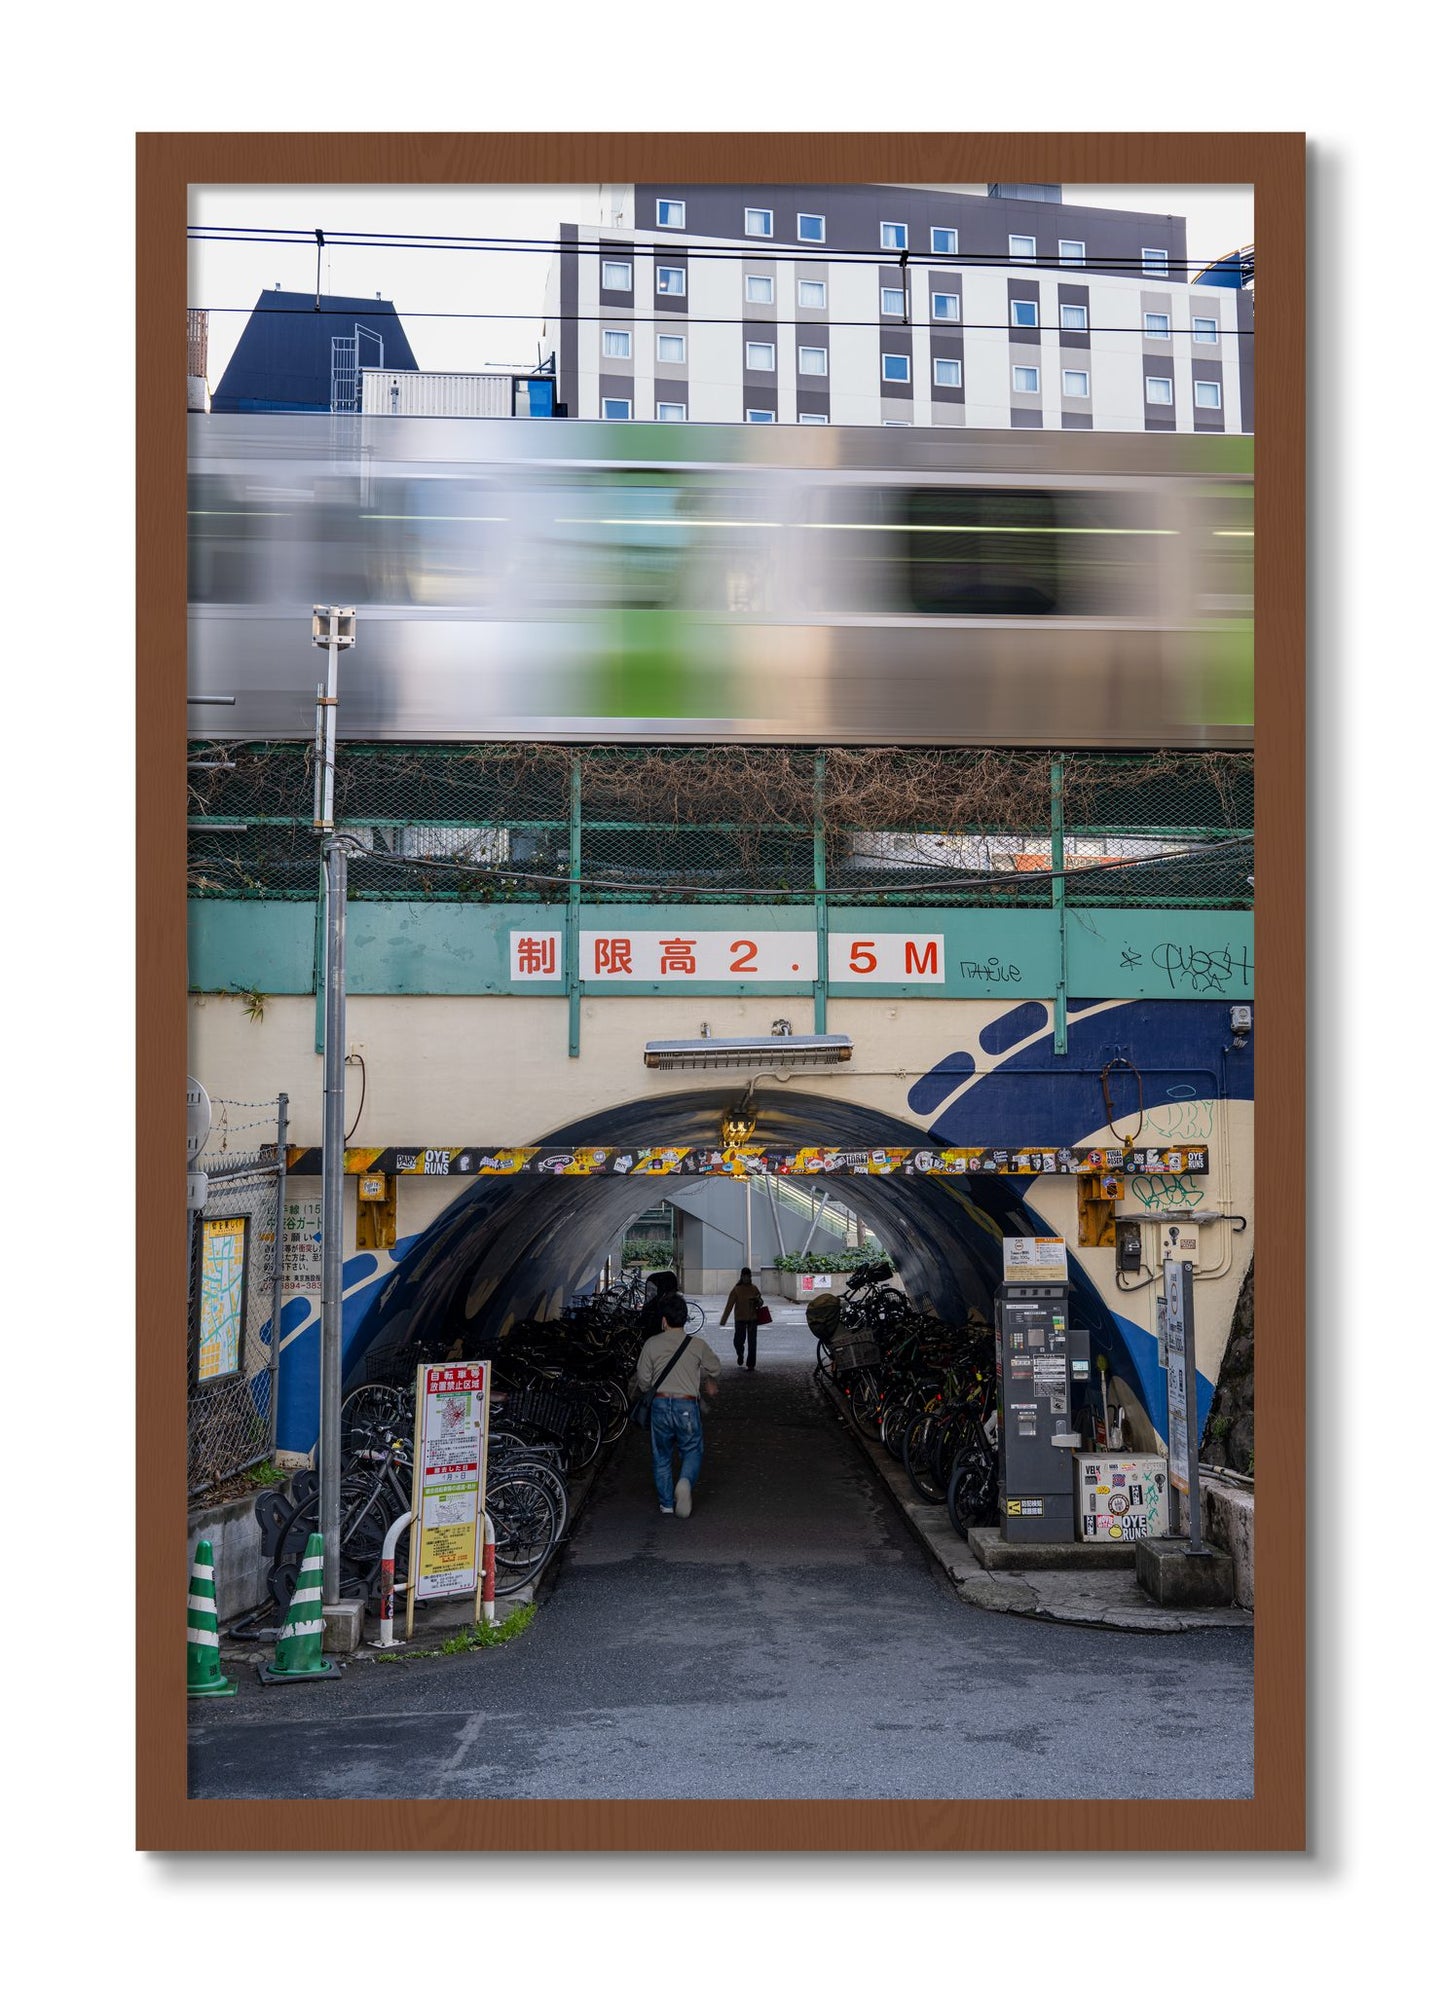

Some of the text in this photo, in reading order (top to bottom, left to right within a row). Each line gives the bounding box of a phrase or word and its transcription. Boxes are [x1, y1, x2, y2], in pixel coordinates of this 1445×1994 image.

[425, 1150, 450, 1163] OYE
[1187, 1152, 1204, 1161] OYE
[424, 1163, 449, 1175] RUNS
[1187, 1160, 1205, 1169] RUNS
[1122, 1515, 1147, 1528] OYE
[1123, 1528, 1148, 1541] RUNS
